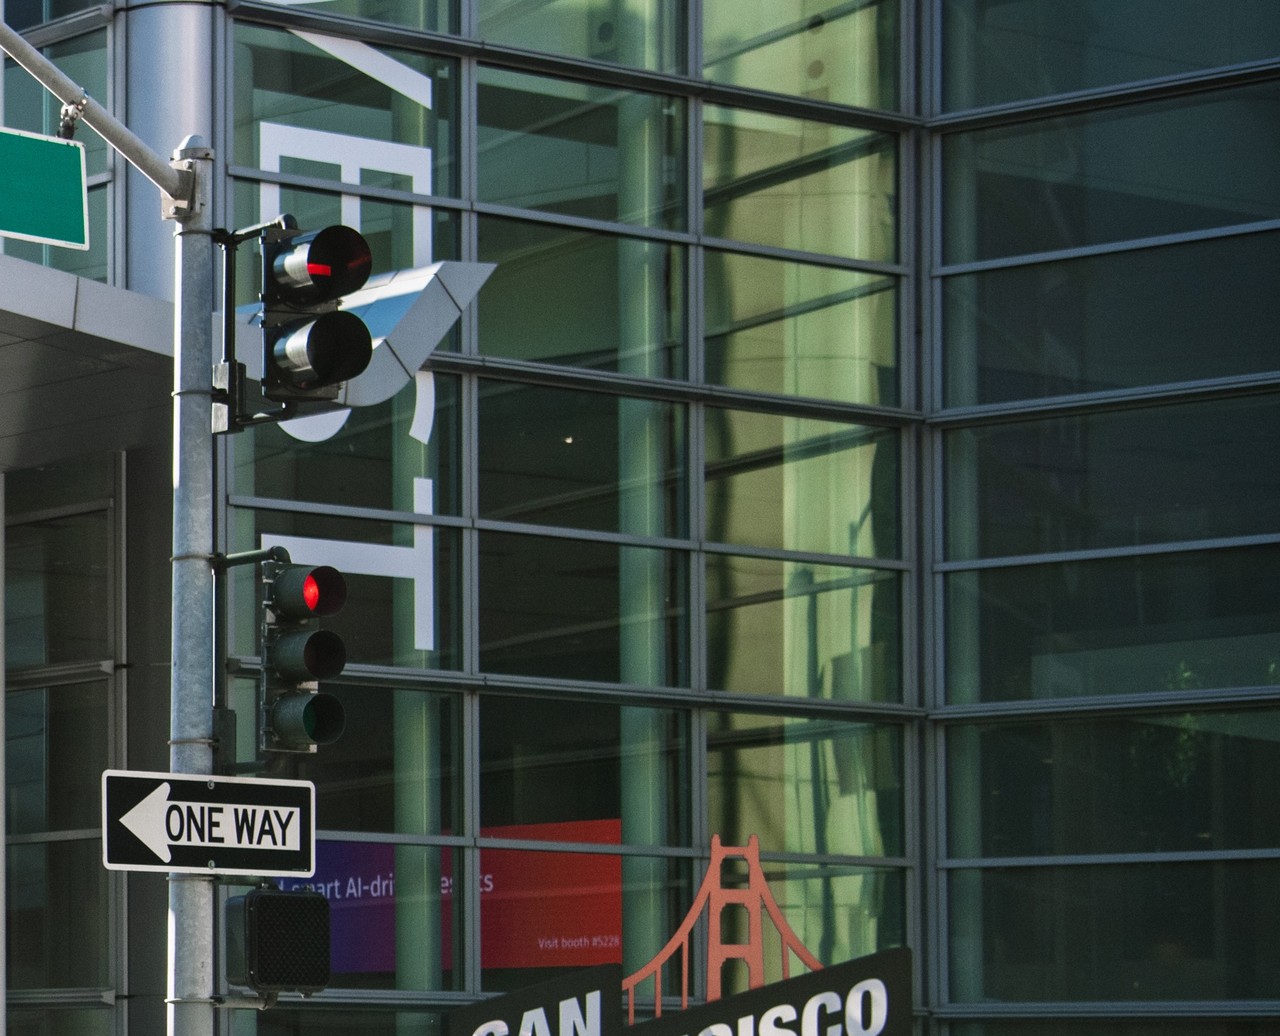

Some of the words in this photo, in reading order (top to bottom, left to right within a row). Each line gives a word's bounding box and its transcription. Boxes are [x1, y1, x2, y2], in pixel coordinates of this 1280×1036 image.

[165, 804, 225, 844] ONE
[233, 808, 295, 847] WAY
[346, 873, 395, 898] AI-dri
[538, 937, 558, 948] Visit
[561, 936, 589, 947] booth
